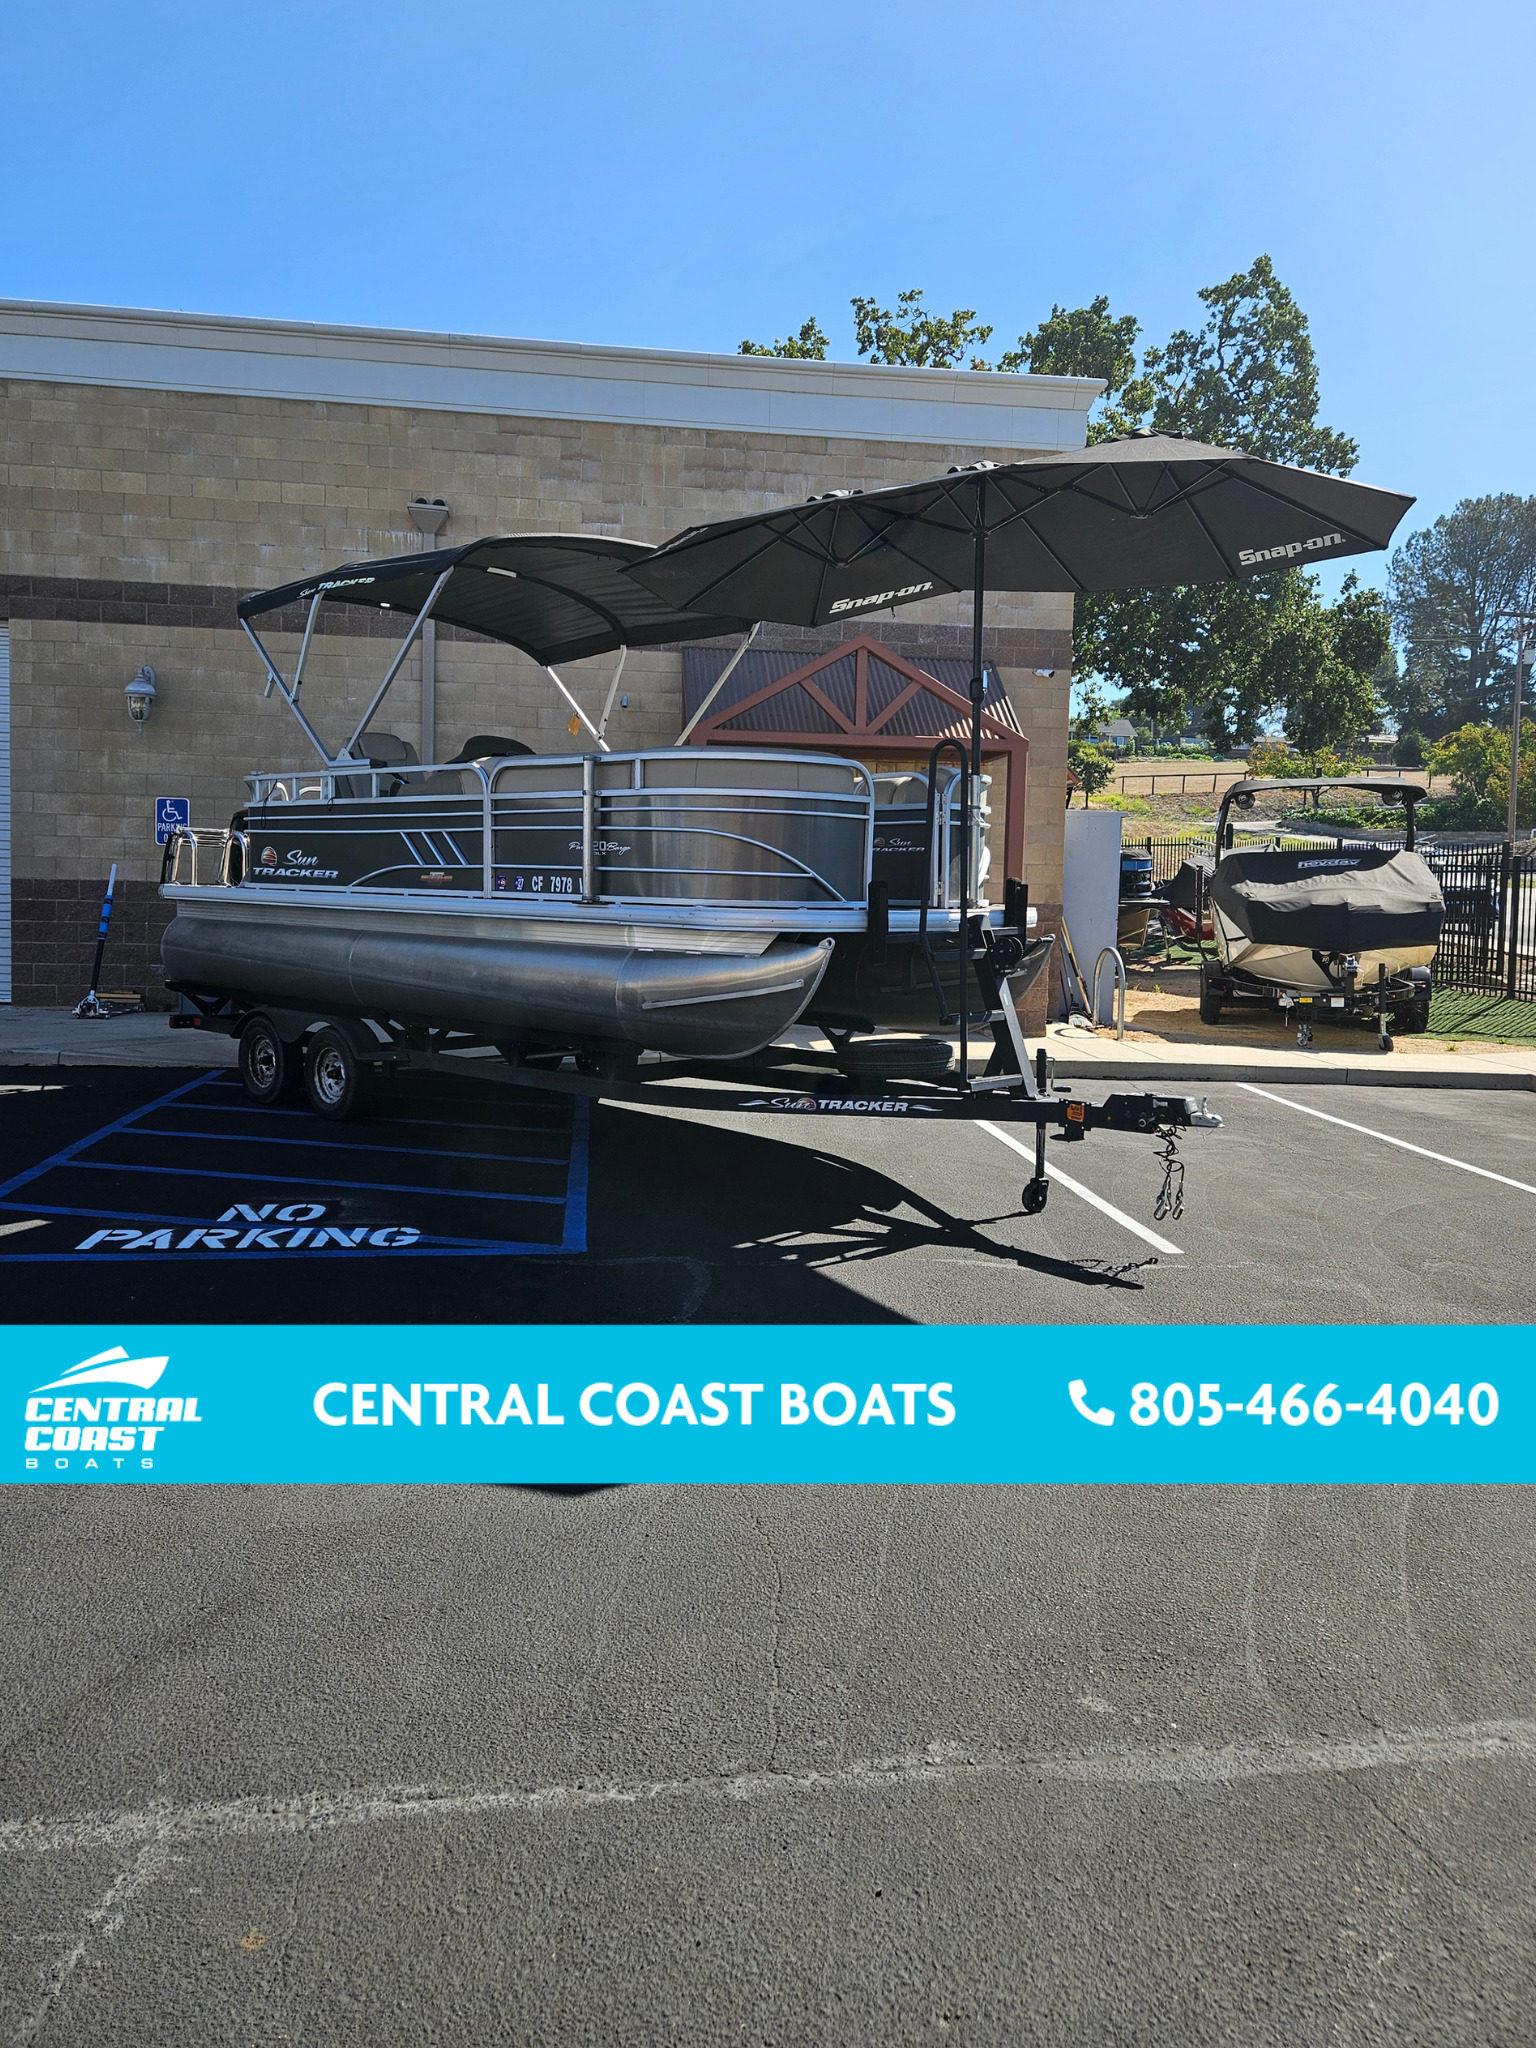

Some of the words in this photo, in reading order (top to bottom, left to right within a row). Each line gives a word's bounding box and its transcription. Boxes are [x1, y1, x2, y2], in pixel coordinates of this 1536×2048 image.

[282, 849, 319, 867] Sun
[253, 867, 339, 879] TRACKER
[531, 875, 543, 892] CF
[550, 876, 573, 893] 7978
[763, 1097, 815, 1111] Sun
[818, 1099, 909, 1112] TRACKER
[217, 1204, 327, 1222] NO
[74, 1227, 421, 1249] PARKING
